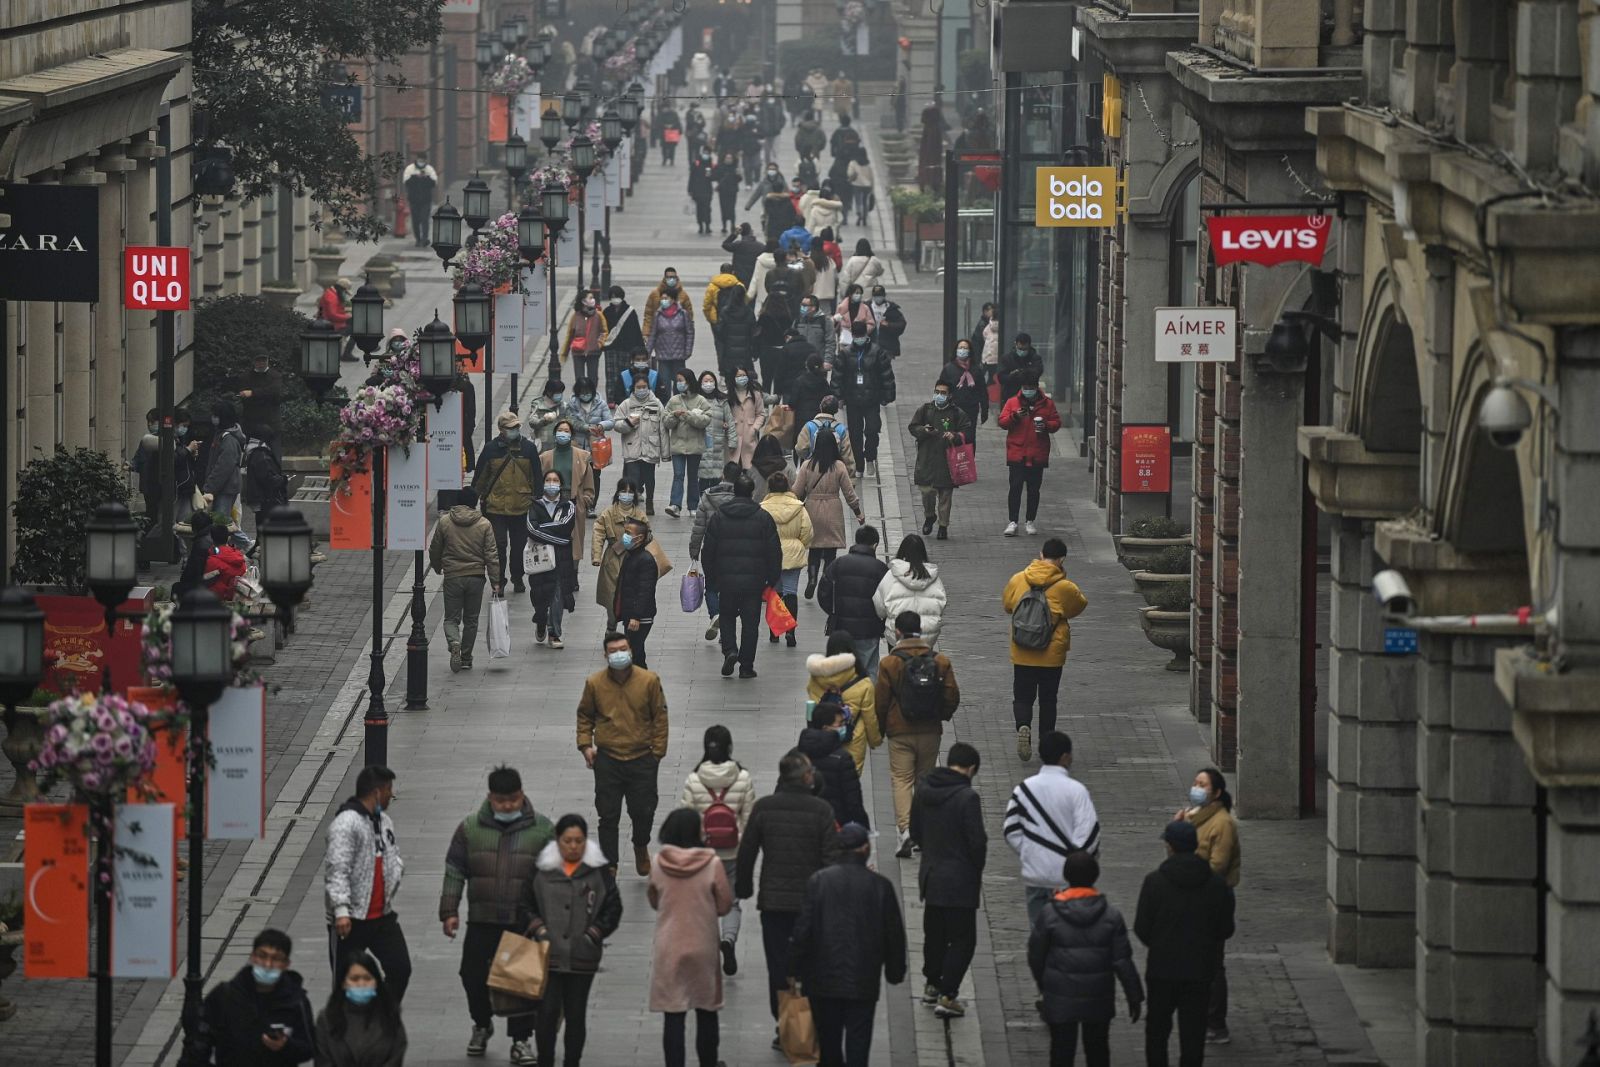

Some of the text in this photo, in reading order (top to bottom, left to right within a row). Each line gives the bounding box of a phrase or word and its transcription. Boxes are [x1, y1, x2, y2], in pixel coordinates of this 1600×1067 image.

[1050, 174, 1103, 197] bala
[1049, 197, 1102, 219] bala
[132, 254, 178, 276] UNI
[132, 280, 182, 305] QLO
